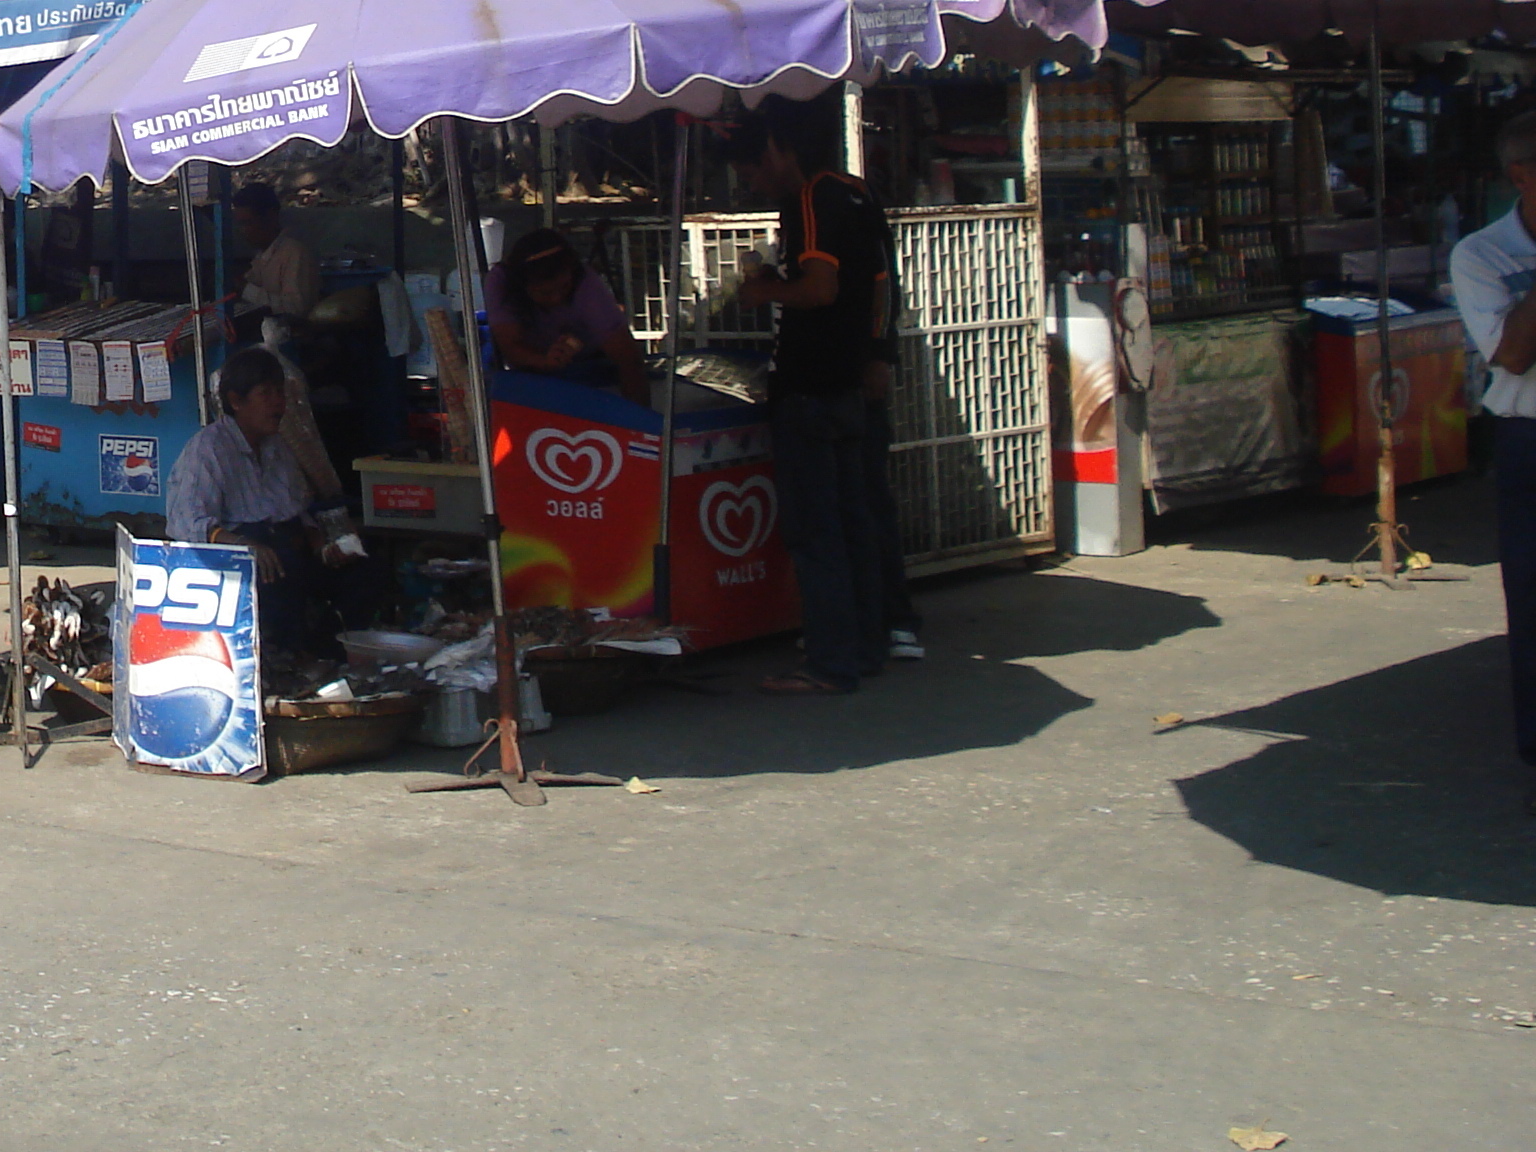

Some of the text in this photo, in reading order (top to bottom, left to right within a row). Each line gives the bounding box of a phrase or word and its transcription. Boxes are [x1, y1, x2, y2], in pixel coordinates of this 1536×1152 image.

[37, 1, 126, 27] ประกันชีวิต
[132, 70, 341, 140] ธนาคารไทยพาณิชย์
[151, 104, 330, 155] SIAM COMMERCIAL BANK
[101, 438, 154, 458] PEPSI
[546, 497, 604, 520] วอลล์
